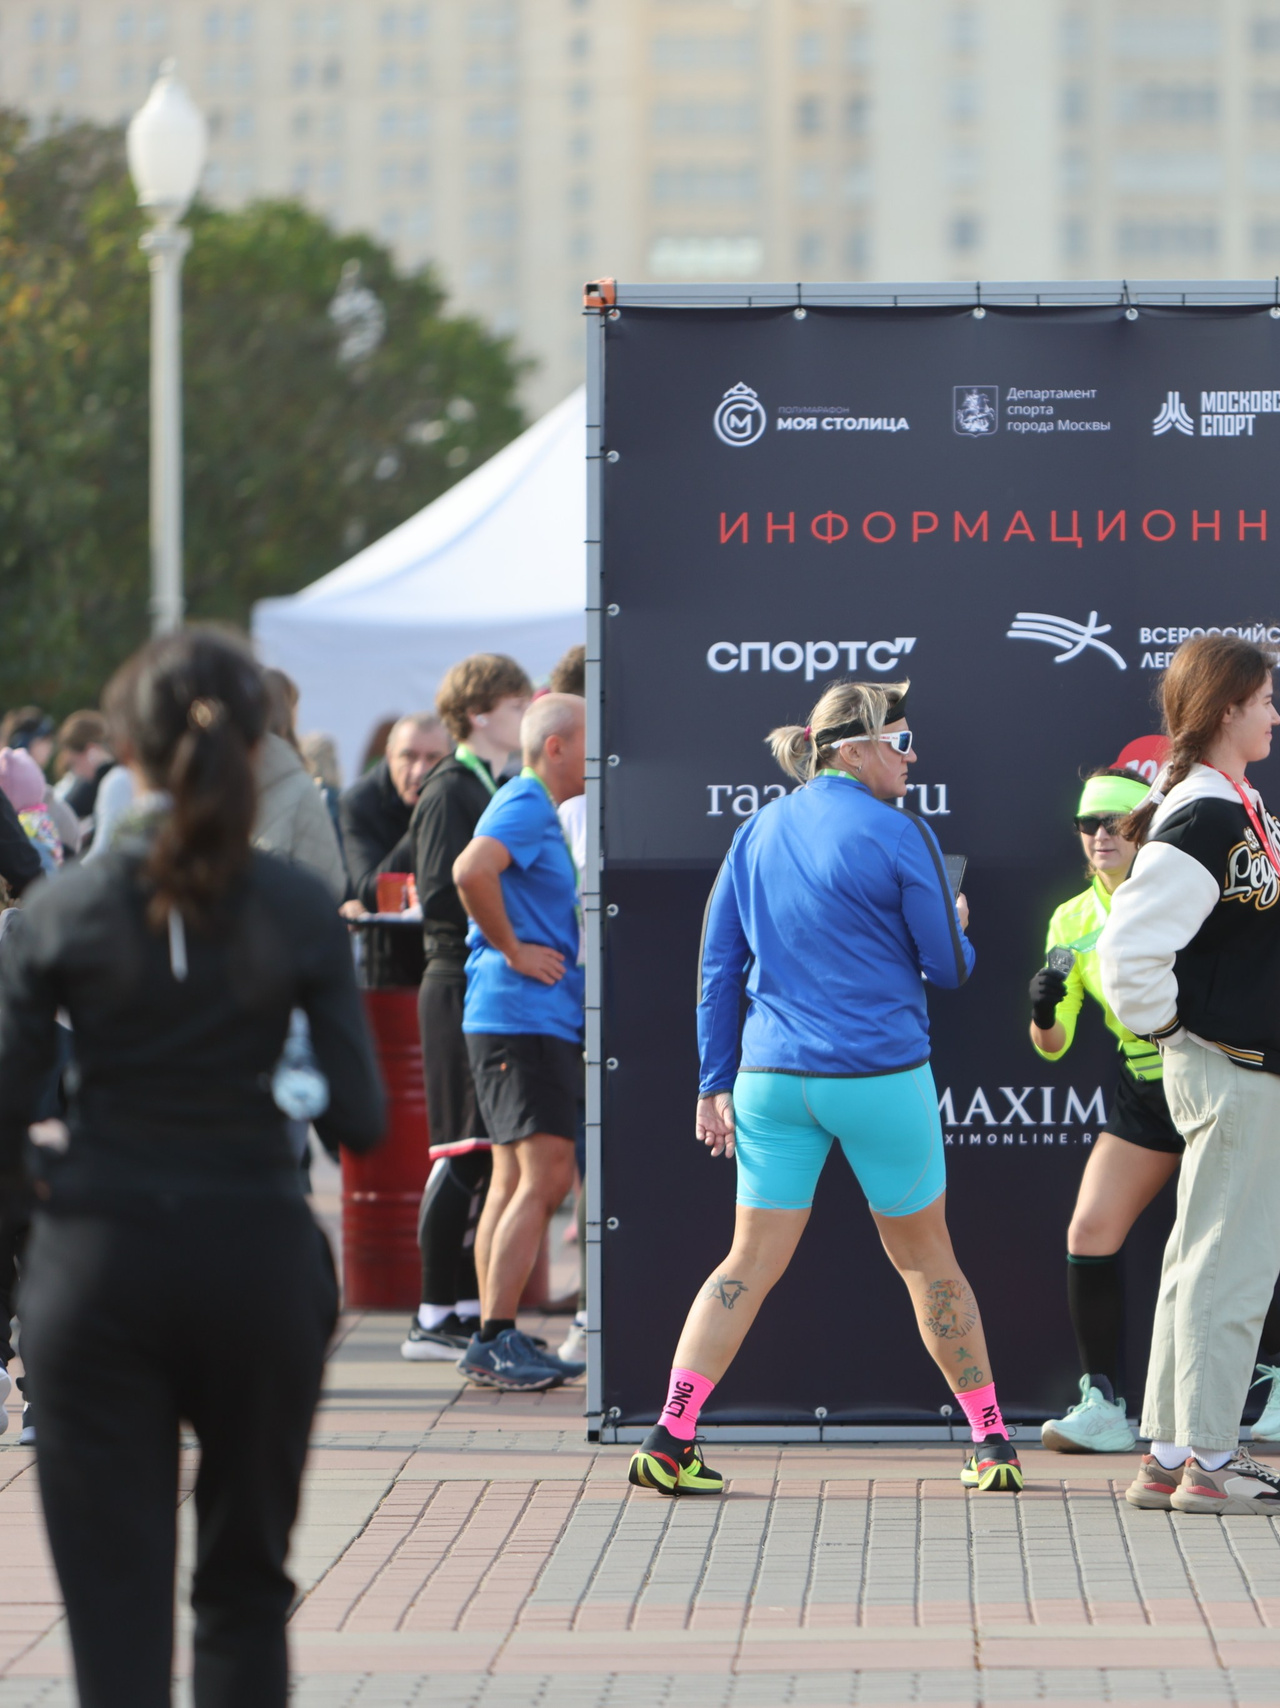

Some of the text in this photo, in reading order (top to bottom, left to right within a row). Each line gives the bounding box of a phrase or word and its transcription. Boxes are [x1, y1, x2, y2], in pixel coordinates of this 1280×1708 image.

[1006, 387, 1097, 402] Департамент
[1006, 404, 1054, 418] спорта
[777, 417, 910, 433] МОЯ СТОЛИЦА
[1006, 420, 1111, 434] города Москвы
[1201, 414, 1256, 436] СПОРТ
[1140, 651, 1171, 669] ЛЕГ
[945, 1133, 1092, 1145] XIMONLINE.R
